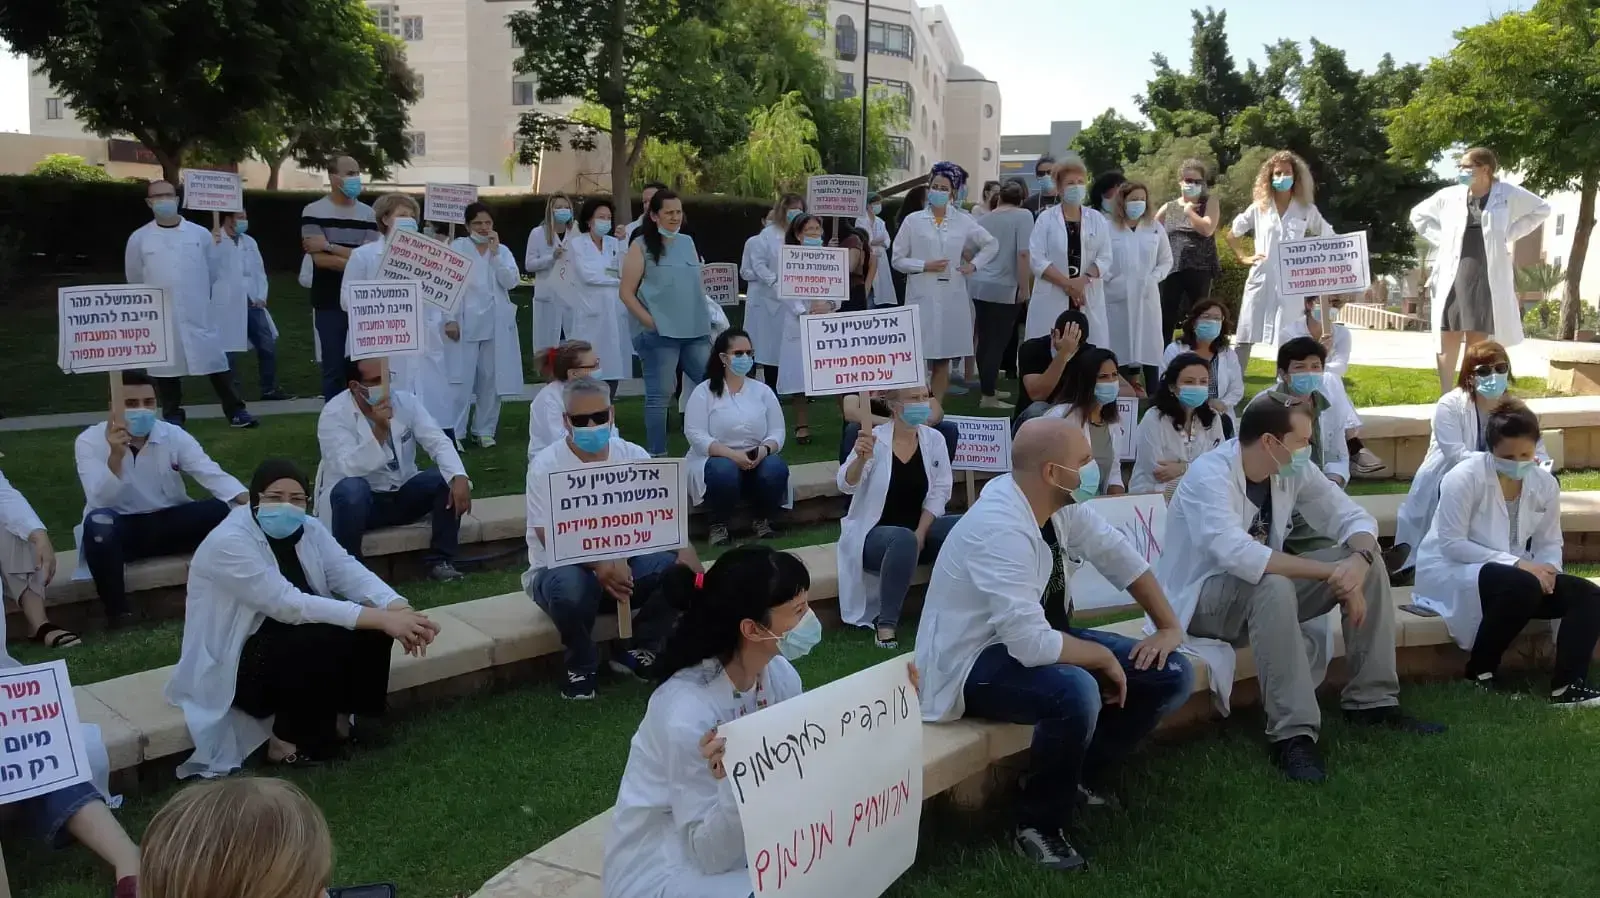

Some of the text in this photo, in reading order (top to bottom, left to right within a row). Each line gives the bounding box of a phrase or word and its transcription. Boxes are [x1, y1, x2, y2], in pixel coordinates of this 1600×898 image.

[399, 234, 410, 245] את
[1286, 240, 1354, 254] הממשלה מהר
[412, 252, 443, 271] המעבדה
[444, 252, 464, 268] משרד
[790, 250, 835, 261] אדלשטיין על
[1283, 251, 1358, 266] חייבת להתעורר
[388, 258, 453, 290] מיום ליום המצב
[444, 266, 465, 281] עובדי
[786, 262, 840, 272] המשמרת נרדם
[1291, 264, 1352, 277] סקטור המעבדות
[1339, 275, 1357, 283] לנגד
[354, 287, 409, 300] הממשלה מהר
[421, 281, 434, 295] הול
[795, 286, 810, 294] אדם
[69, 292, 153, 308] הממשלה מהר
[434, 291, 448, 302] רק
[353, 303, 413, 316] חייבת להתעורר
[68, 310, 159, 326] חייבת להתעורר
[822, 317, 898, 335] אדלשטיין על
[74, 328, 150, 343] סקטור המעבדות
[395, 332, 411, 344] לנגד
[817, 332, 906, 350] המשמרת נרדם
[70, 342, 157, 360] לנגד עינינו מתפורר
[814, 351, 912, 370] צריך תוספת מיידית
[836, 368, 893, 384] של כח אדם
[960, 422, 1003, 431] בתנאי עבודה
[969, 433, 995, 442] עומדים
[969, 444, 989, 452] הכרה
[990, 444, 1001, 452] לא
[967, 455, 997, 463] ומינימום
[567, 467, 660, 490] אדלשטיין על
[561, 487, 669, 511] המשמרת נרדם
[557, 508, 674, 535] צריך תוספת מיידית
[583, 529, 652, 550] של כח אדם
[0, 680, 41, 700] משר
[12, 702, 60, 724] עובדי
[4, 730, 52, 754] מיום
[732, 685, 909, 804] עובדים במקסימום
[0, 755, 59, 782] רק הו
[754, 810, 834, 892] מינימום
